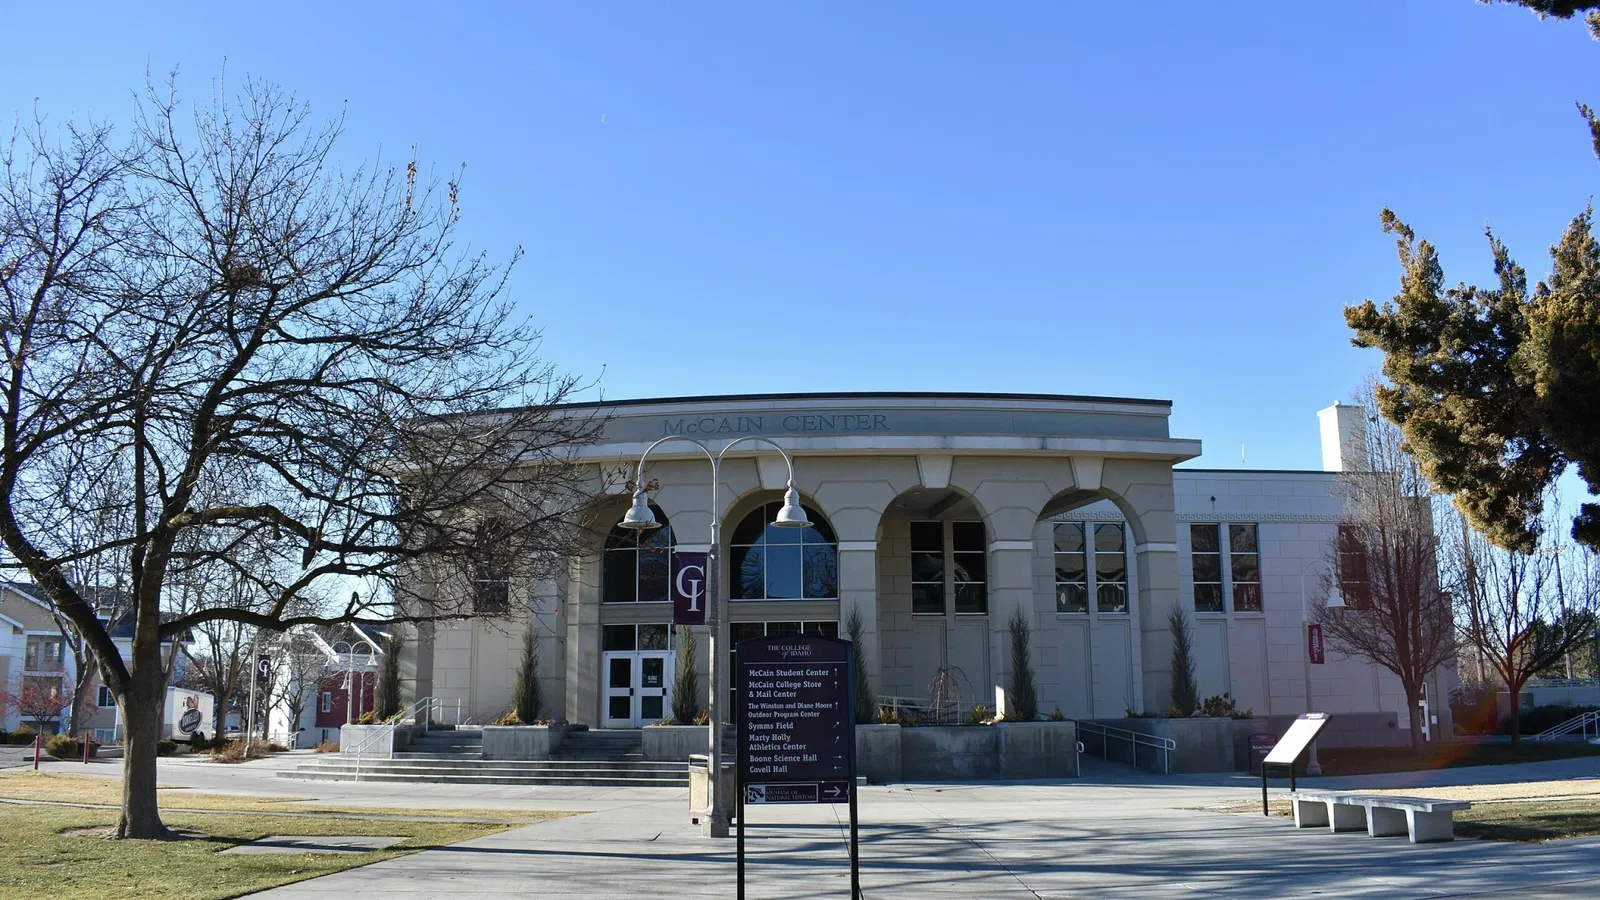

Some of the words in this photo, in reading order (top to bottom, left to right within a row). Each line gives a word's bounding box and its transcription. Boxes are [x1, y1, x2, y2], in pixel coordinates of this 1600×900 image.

[662, 416, 764, 435] McCAIN
[782, 414, 890, 431] CENTER
[776, 681, 801, 689] College
[748, 722, 774, 731] Symms
[749, 734, 770, 742] Marty
[772, 734, 791, 742] Holly
